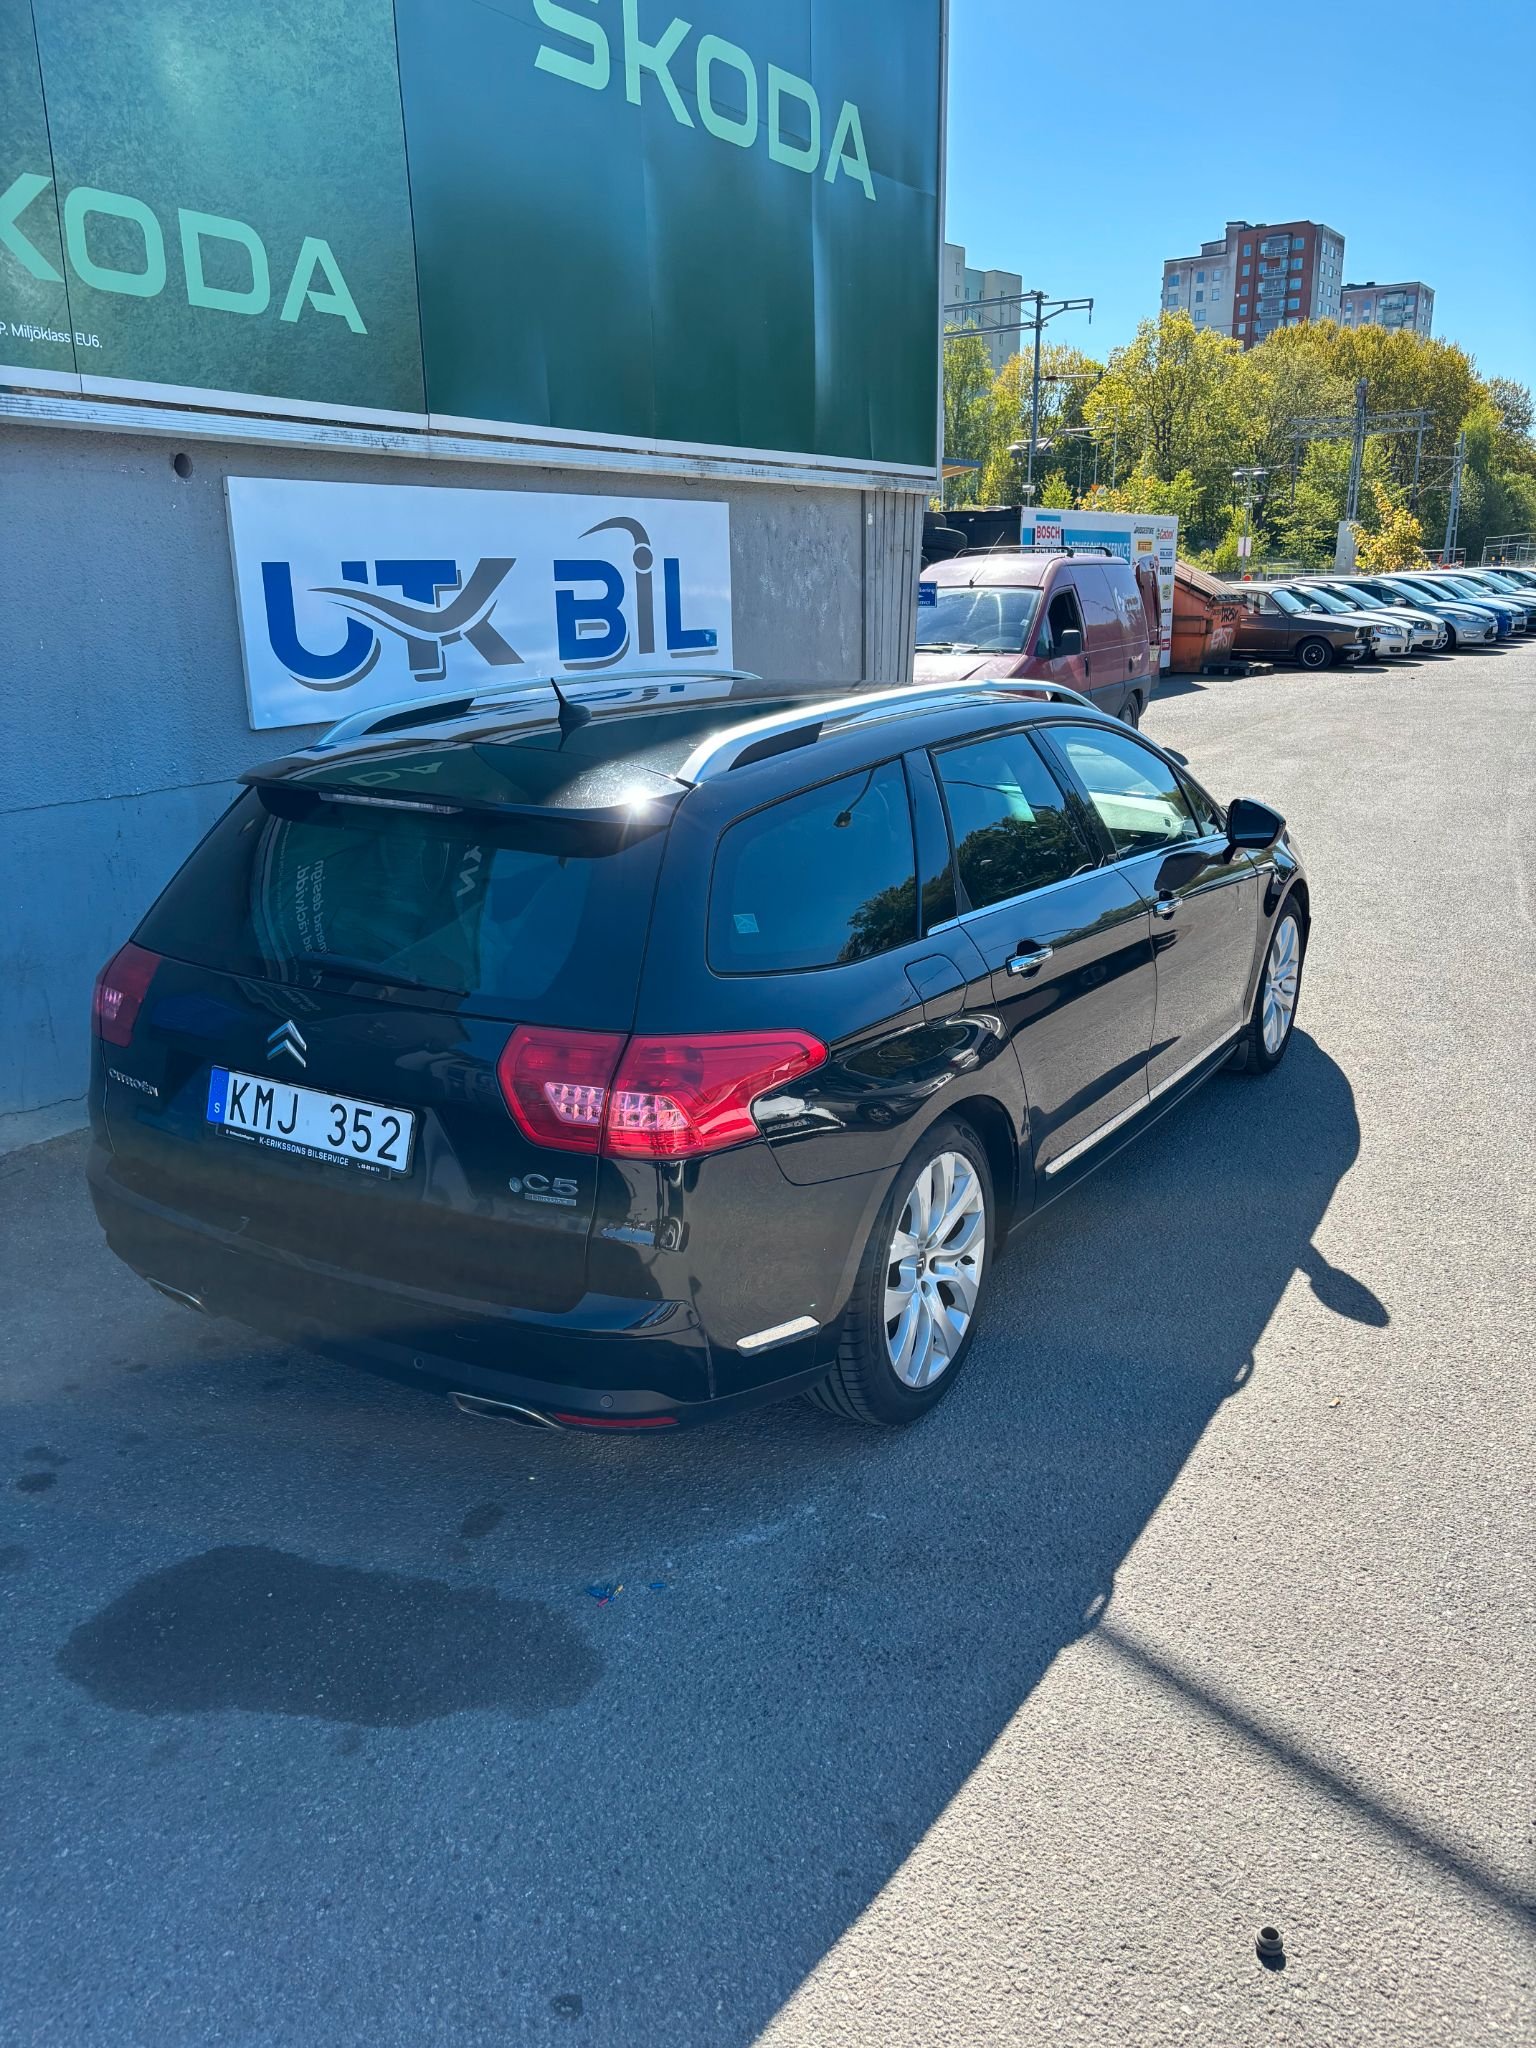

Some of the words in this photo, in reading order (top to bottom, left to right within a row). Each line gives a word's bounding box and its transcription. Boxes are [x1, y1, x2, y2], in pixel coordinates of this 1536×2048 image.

[11, 323, 71, 342] Miljöklass
[75, 332, 103, 348] EU6.
[1036, 526, 1060, 539] BOSCH
[108, 1067, 159, 1097] CITROËN
[214, 1102, 221, 1113] S
[229, 1079, 298, 1134] KMJ
[327, 1103, 402, 1162] 352
[259, 1136, 306, 1155] K-ERIKSSONS
[307, 1149, 349, 1166] BILSERVICE
[522, 1173, 579, 1196] C5
